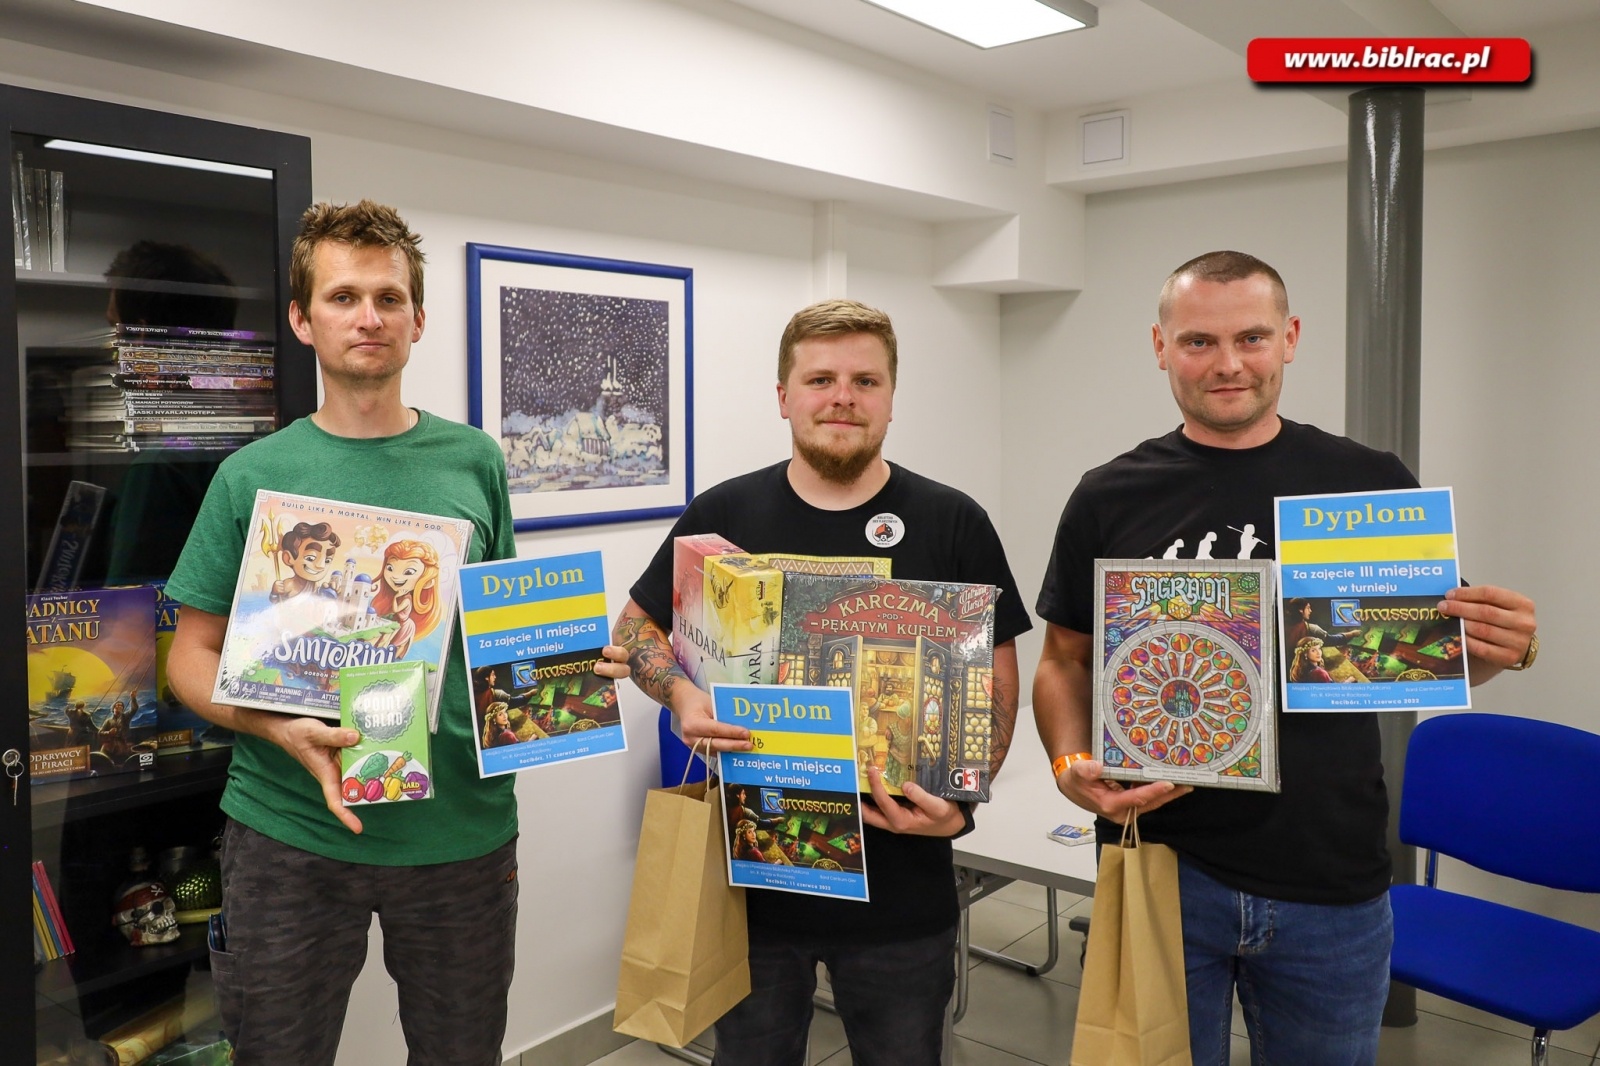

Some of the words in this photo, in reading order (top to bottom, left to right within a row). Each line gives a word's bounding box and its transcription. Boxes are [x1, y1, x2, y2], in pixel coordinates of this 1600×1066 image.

[281, 501, 305, 509] BUILD
[1303, 503, 1426, 531] Dyplom
[1293, 570, 1307, 580] Za
[1311, 568, 1355, 581] zajęcie
[1360, 566, 1374, 577] III
[1379, 564, 1443, 579] miejsca
[481, 567, 584, 599] Dyplom
[1351, 582, 1398, 594] turnieju
[1130, 575, 1233, 620] SAGRADA
[26, 599, 100, 618] ADNICY
[838, 594, 940, 623] KARCZMA
[479, 639, 492, 649] Za
[494, 633, 531, 648] zajęcie
[536, 629, 543, 640] II
[547, 623, 597, 639] miejsca
[821, 619, 888, 637] PĘKATYM
[897, 624, 957, 638] KUFLEM
[516, 648, 525, 657] w
[527, 642, 564, 656] turnieju
[679, 615, 727, 668] HADARA
[275, 687, 303, 697] WARNING:
[732, 697, 831, 723] Dyplom
[365, 712, 402, 729] SALAD
[42, 759, 72, 769] PIRACI
[732, 758, 744, 767] Za
[746, 759, 781, 771] zajęcie
[785, 760, 789, 771] I
[792, 761, 841, 776] miejsca
[775, 774, 811, 786] turnieju
[764, 792, 852, 815] Carcassonne
